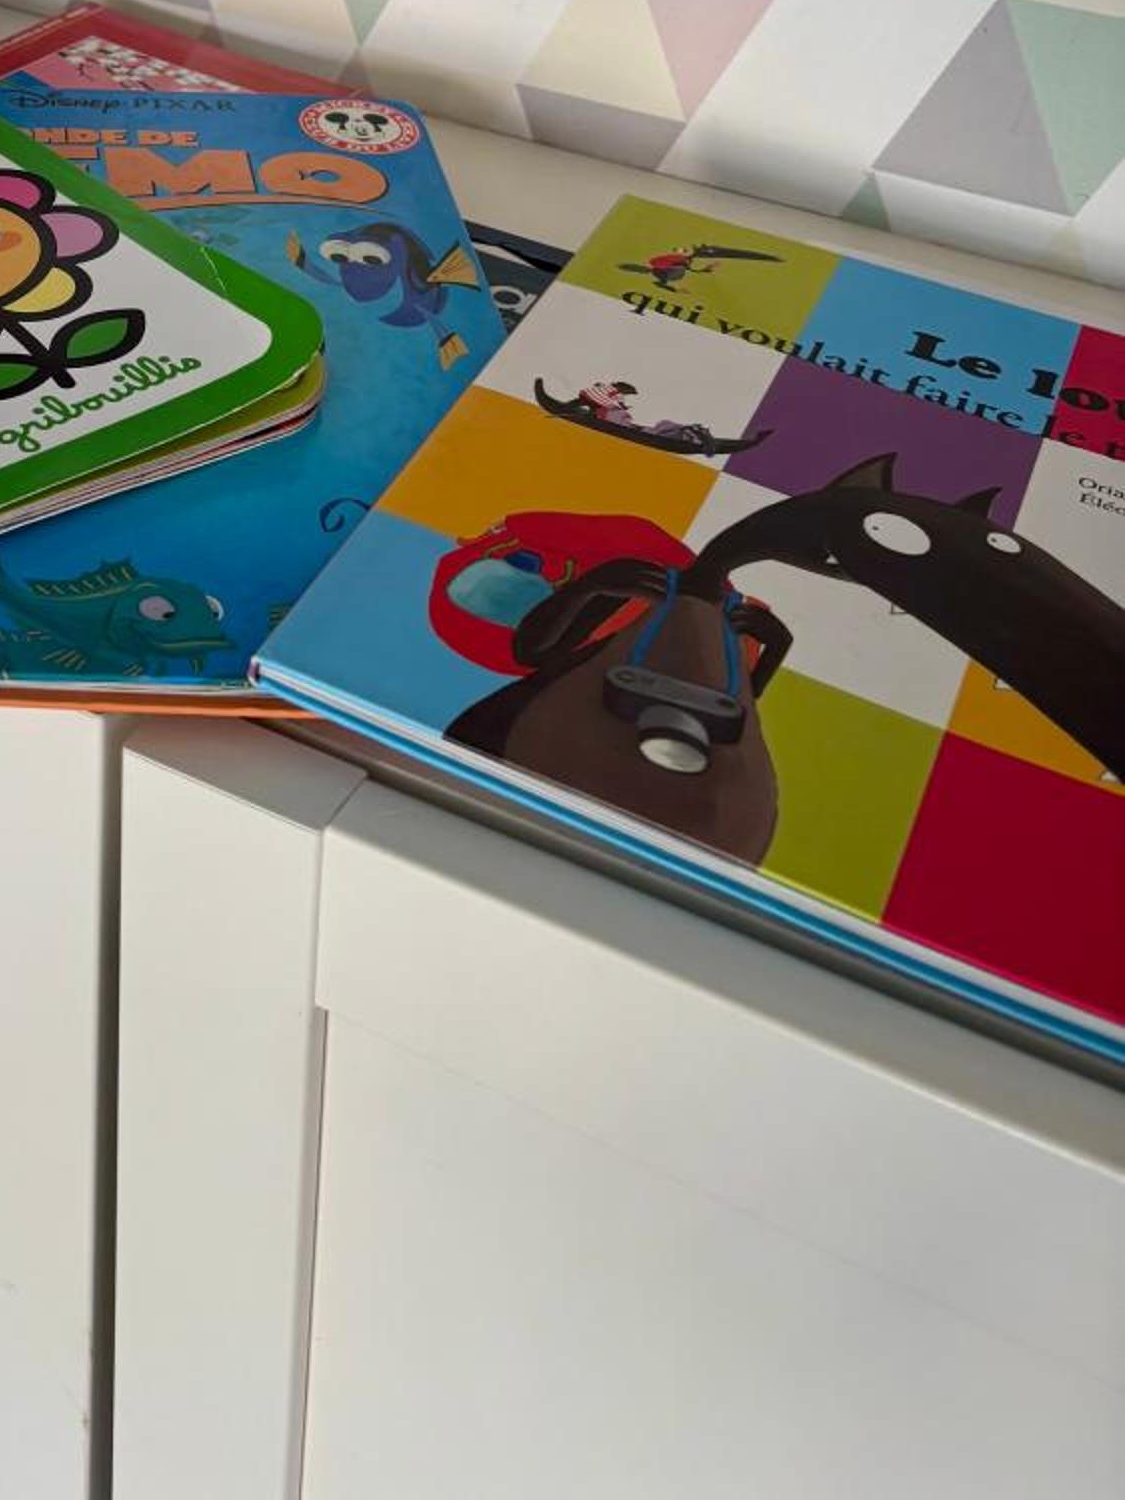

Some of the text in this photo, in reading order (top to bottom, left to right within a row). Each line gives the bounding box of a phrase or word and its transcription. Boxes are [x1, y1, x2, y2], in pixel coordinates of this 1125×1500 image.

[131, 97, 237, 113] PIXAR
[27, 126, 202, 149] NDE DE
[55, 146, 390, 203] MO
[621, 291, 703, 325] qui
[717, 317, 893, 387] voulait
[898, 375, 1025, 430] faire
[905, 331, 1004, 381] Le
